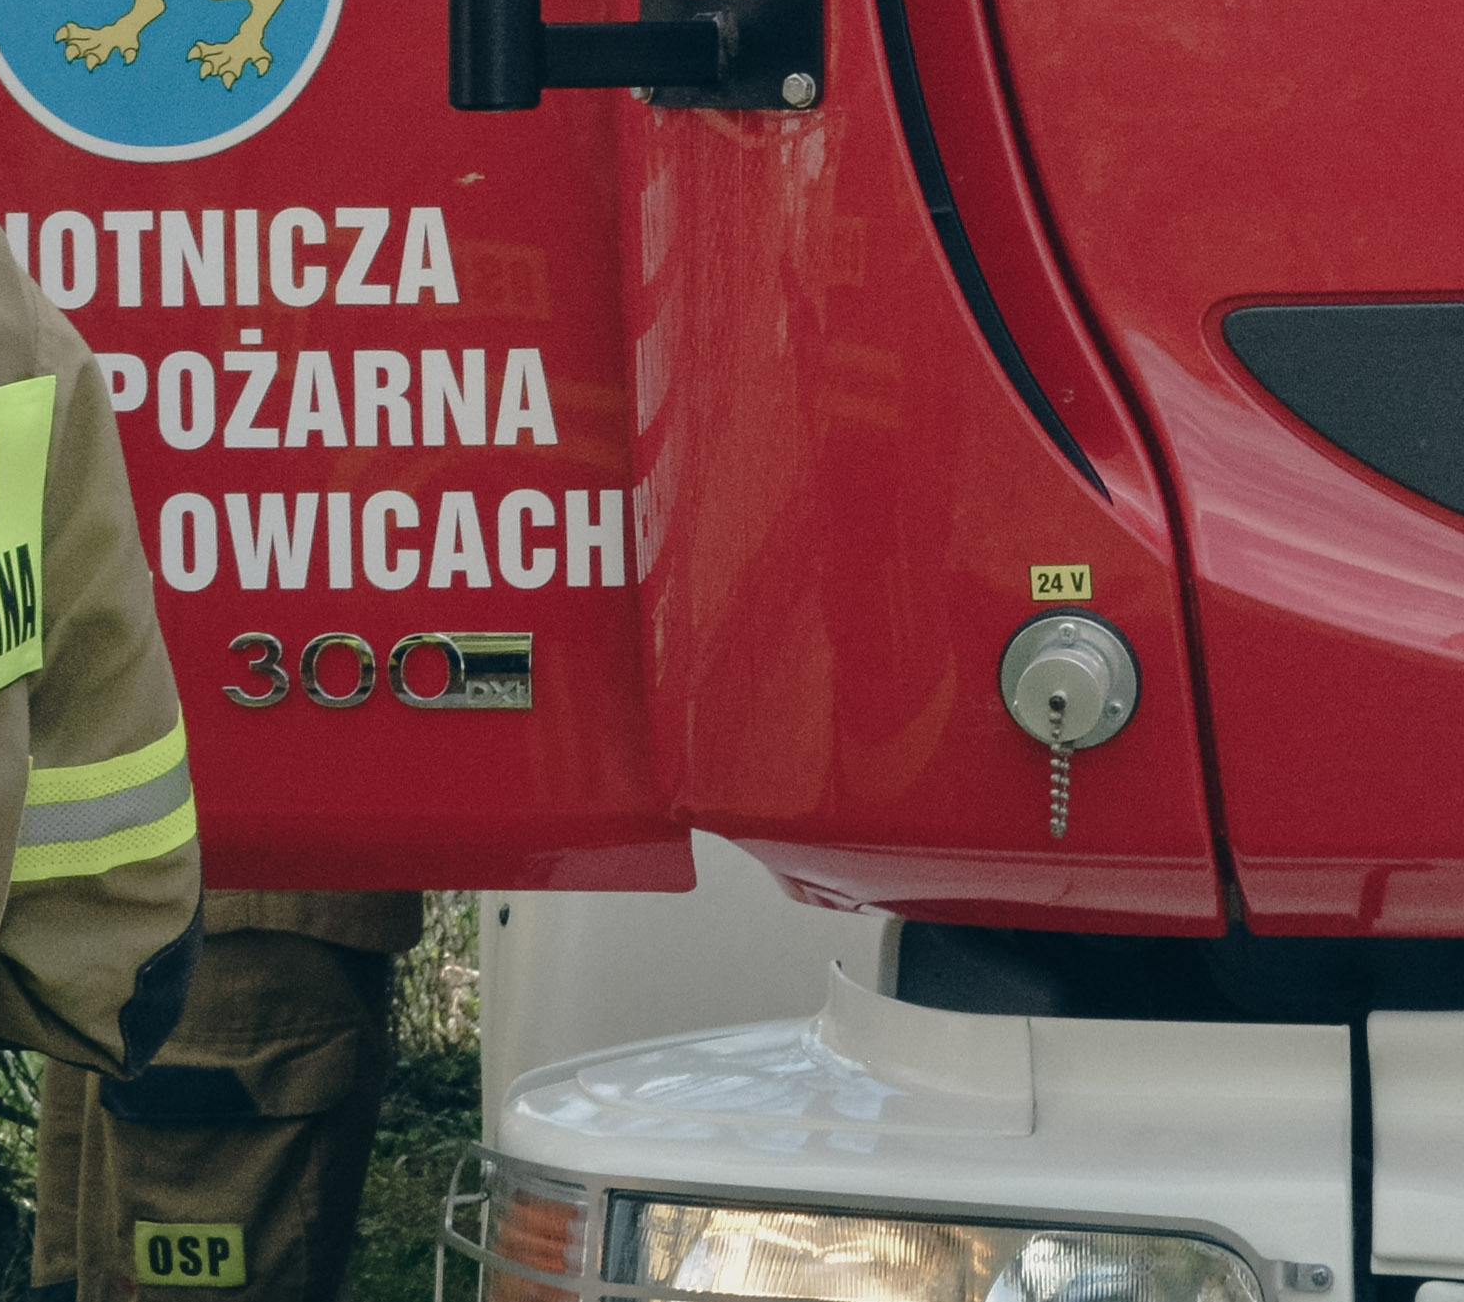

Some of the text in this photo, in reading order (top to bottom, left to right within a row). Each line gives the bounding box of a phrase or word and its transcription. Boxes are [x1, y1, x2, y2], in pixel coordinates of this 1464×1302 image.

[5, 207, 459, 310] OTNICZA
[149, 489, 626, 592] OWICACH
[1037, 572, 1084, 593] 24 V
[222, 631, 465, 708] 300
[148, 1235, 230, 1277] OSP
